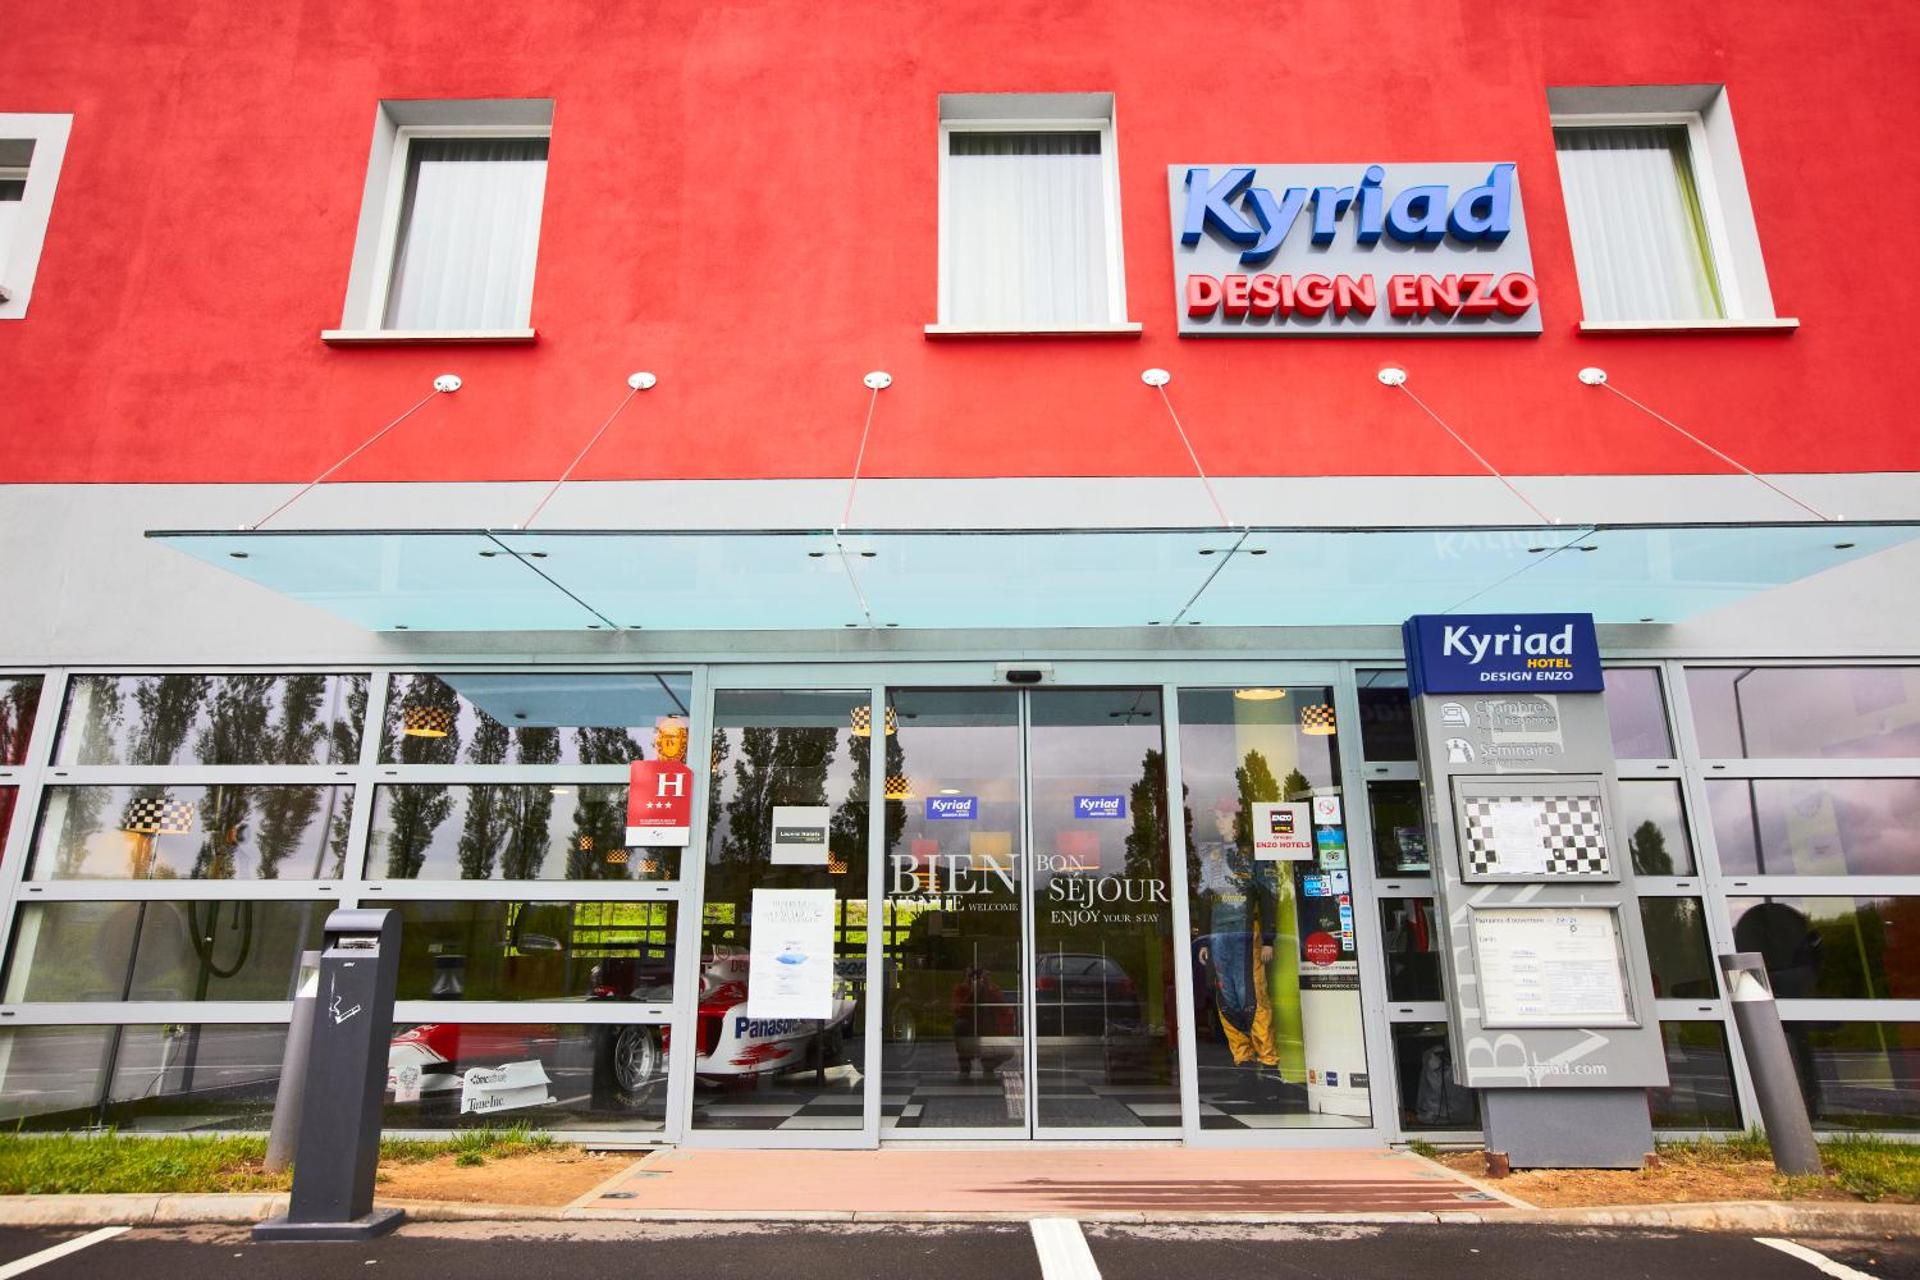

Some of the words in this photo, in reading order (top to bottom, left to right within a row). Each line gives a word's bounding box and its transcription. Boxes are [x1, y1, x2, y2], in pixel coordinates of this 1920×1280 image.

[1181, 164, 1515, 265] Kyriad
[1186, 274, 1377, 317] DESIGN
[1388, 272, 1538, 317] ENZO
[1443, 624, 1574, 664] Kyriad
[1527, 658, 1572, 668] HOTEL
[1480, 672, 1532, 682] DESIGN
[1536, 671, 1574, 681] ENZO
[1474, 700, 1550, 714] Chambres
[655, 772, 687, 797] H
[932, 799, 972, 812] Kyriad
[1080, 798, 1119, 811] Kyriad
[1037, 854, 1085, 872] BON
[888, 854, 1020, 895] BIEN
[1049, 872, 1169, 909] SÉJOUR
[968, 903, 1019, 912] WELCOME
[1051, 910, 1100, 927] ENJOY
[1103, 914, 1131, 923] YOUR
[1136, 914, 1160, 923] STAY
